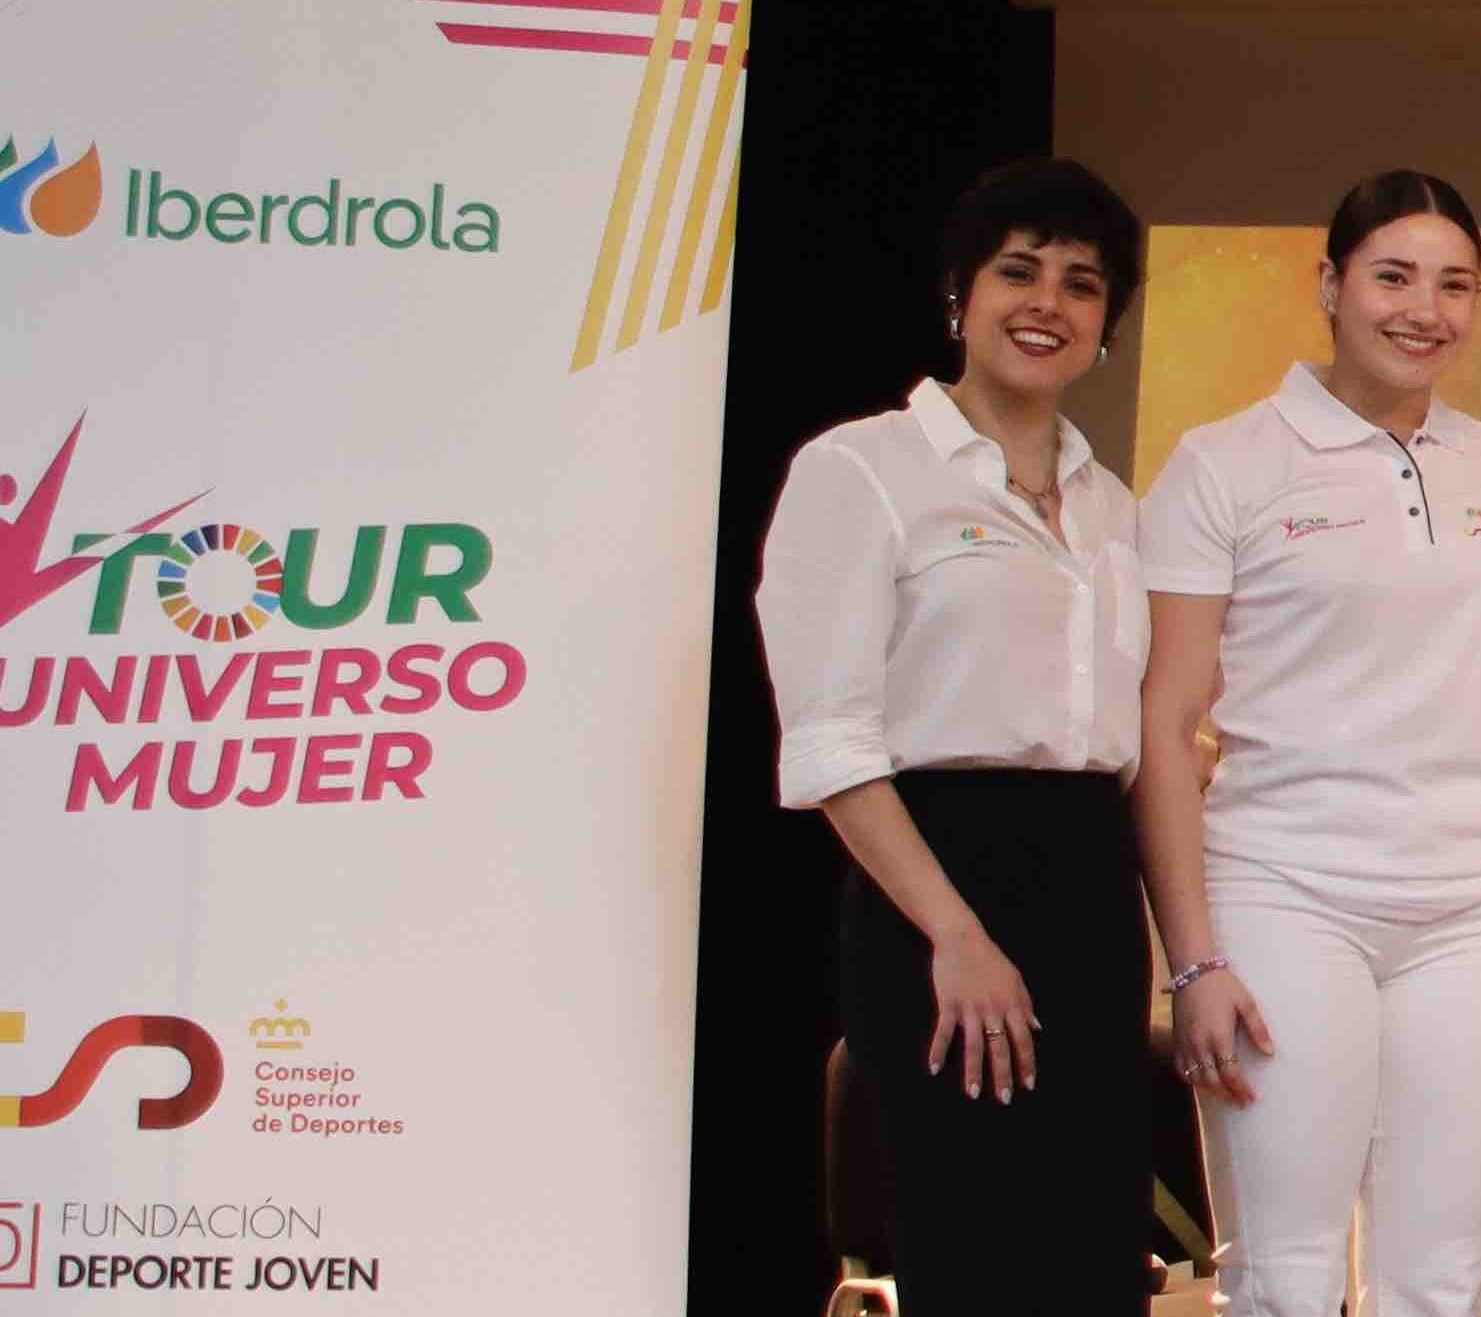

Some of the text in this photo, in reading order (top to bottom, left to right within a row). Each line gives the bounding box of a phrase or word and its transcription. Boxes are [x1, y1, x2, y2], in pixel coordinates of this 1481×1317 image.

[125, 168, 500, 255] Iberdrola
[71, 522, 494, 643] TOUR
[65, 731, 433, 813] MUJER
[254, 1061, 356, 1086] Consejo
[254, 1087, 361, 1112] Superior
[252, 1113, 404, 1137] de Deportes
[61, 1196, 322, 1240] FUNDACIÓN
[57, 1254, 379, 1292] DEPORTE JOVEN
